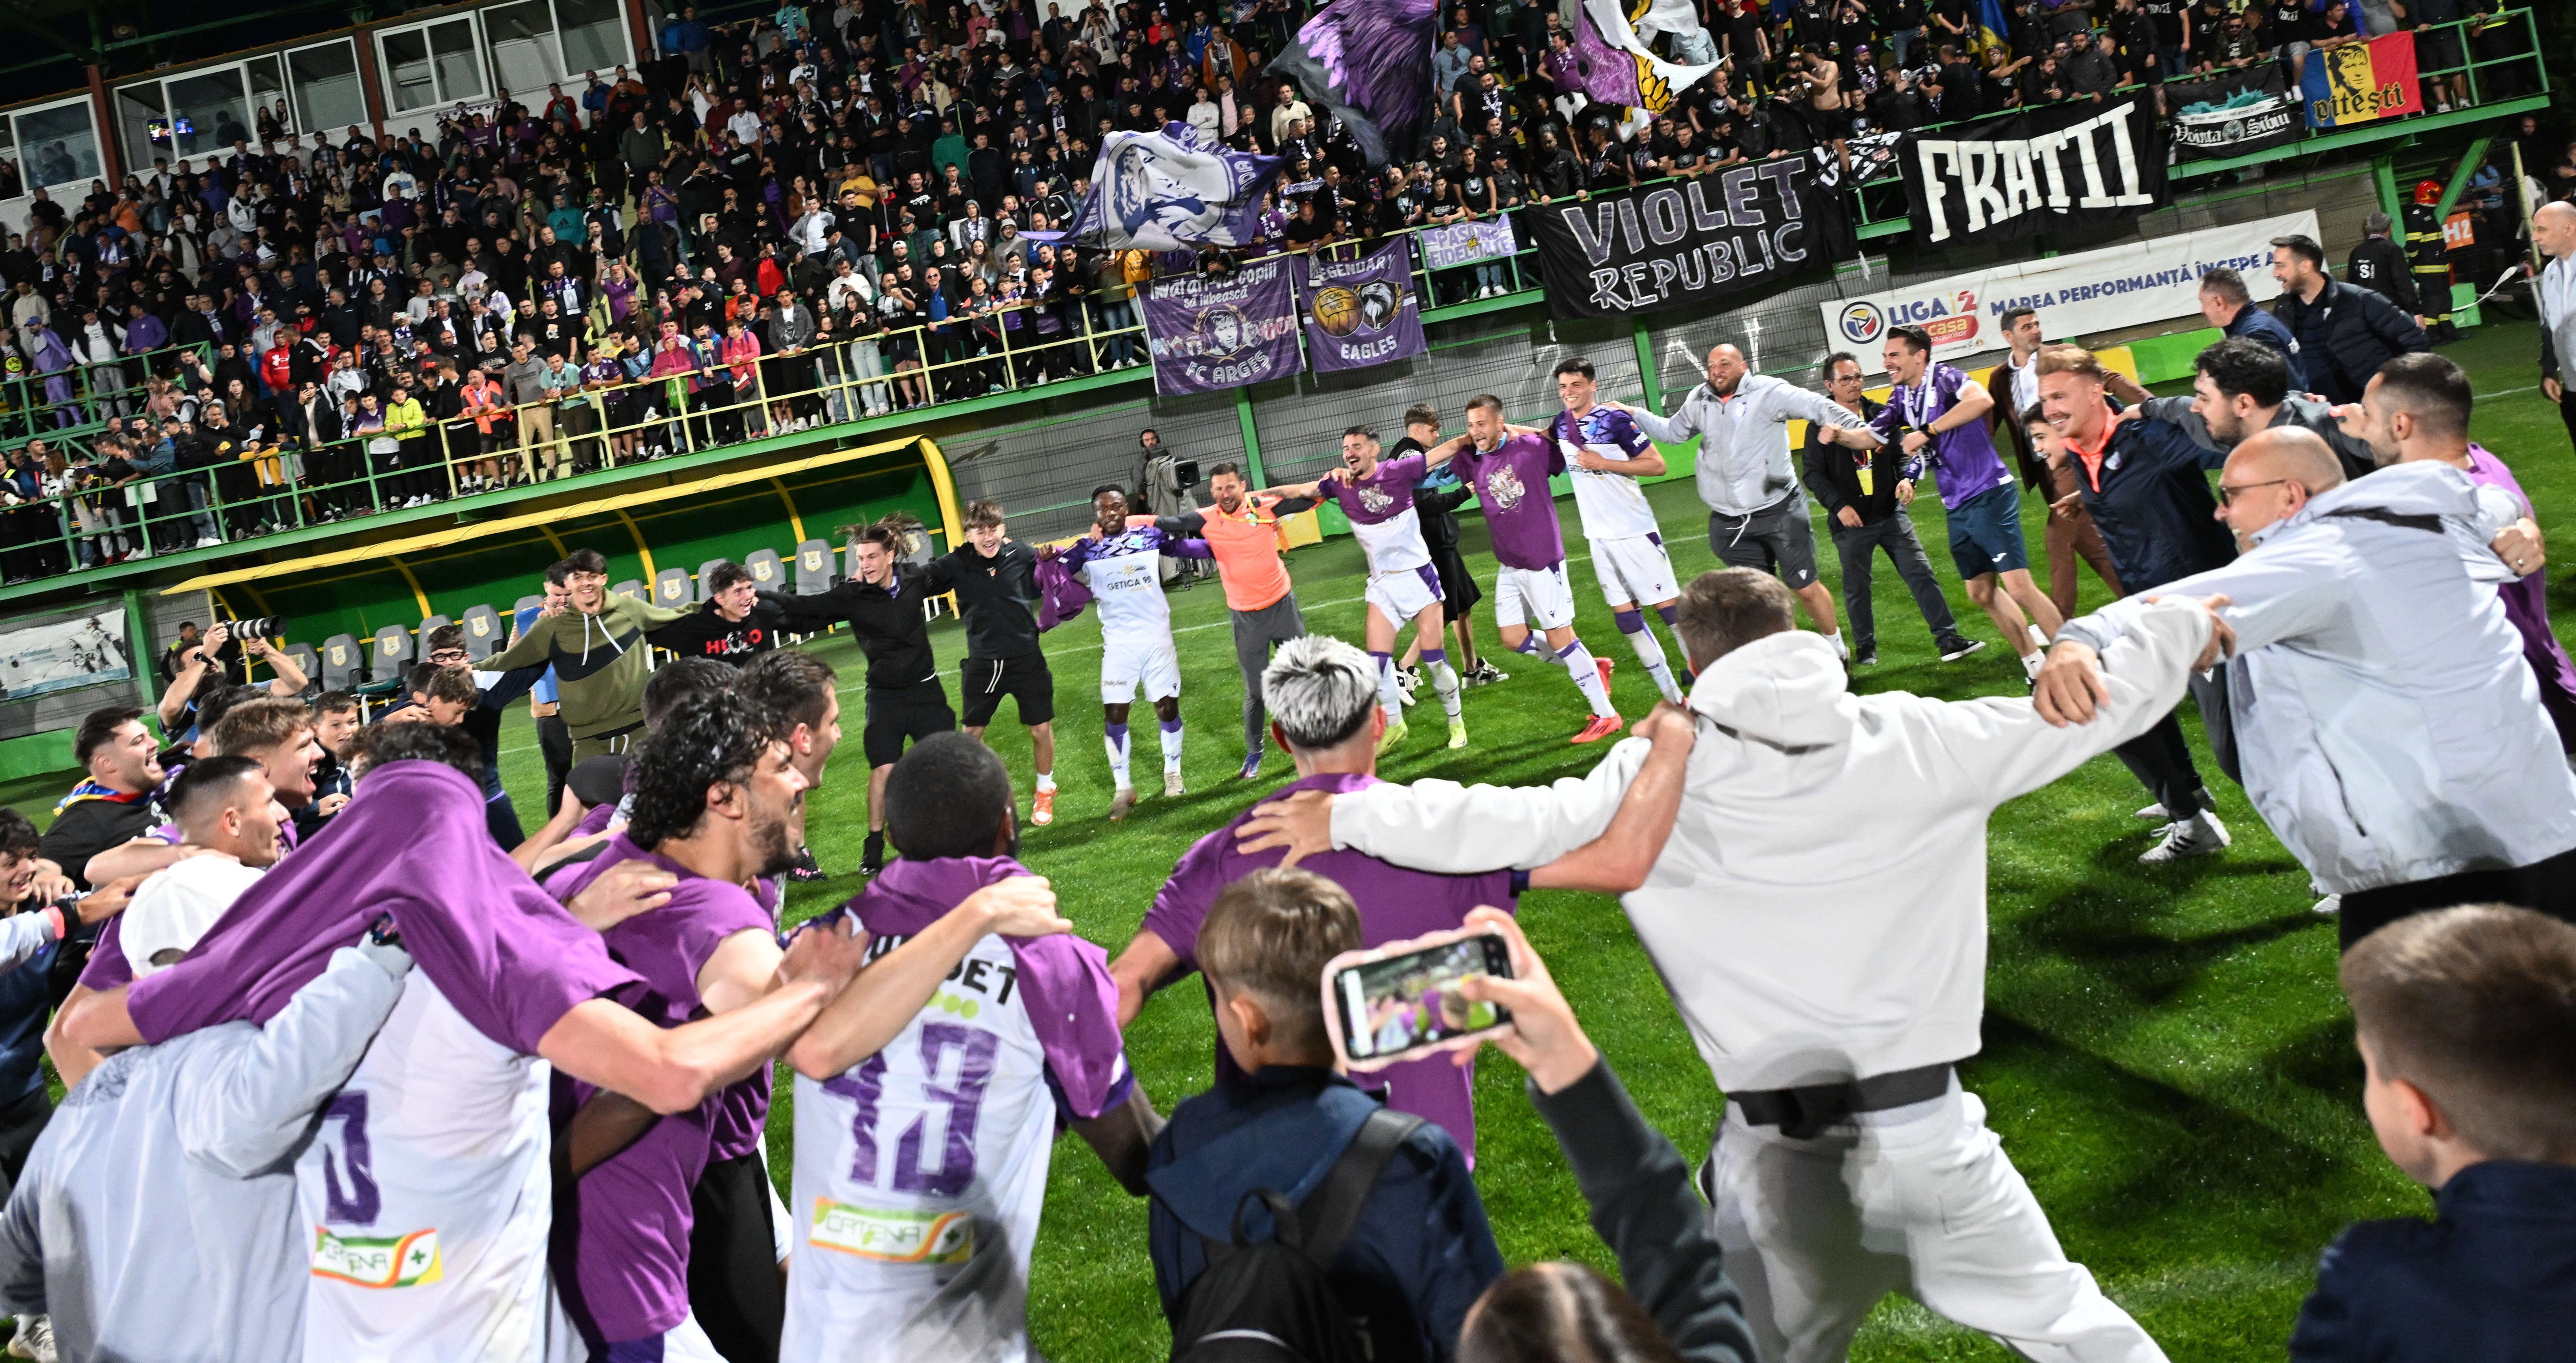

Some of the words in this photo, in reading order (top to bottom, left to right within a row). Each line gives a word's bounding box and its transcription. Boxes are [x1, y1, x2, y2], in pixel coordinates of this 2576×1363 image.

[1561, 157, 1806, 267] VIOLET
[1319, 254, 1396, 281] EGENDARY
[1589, 222, 1807, 311] REPUBLIC
[1200, 286, 1248, 306] iubească
[1990, 292, 2056, 315] MAREA
[2059, 263, 2193, 304] PERFORMANȚĂ
[1888, 297, 1948, 326] LIGA
[1958, 291, 1977, 313] 2
[1928, 318, 1968, 336] casa
[1341, 335, 1398, 360] EAGLES
[1186, 361, 1207, 382] FC
[1107, 578, 1141, 590] GETICA
